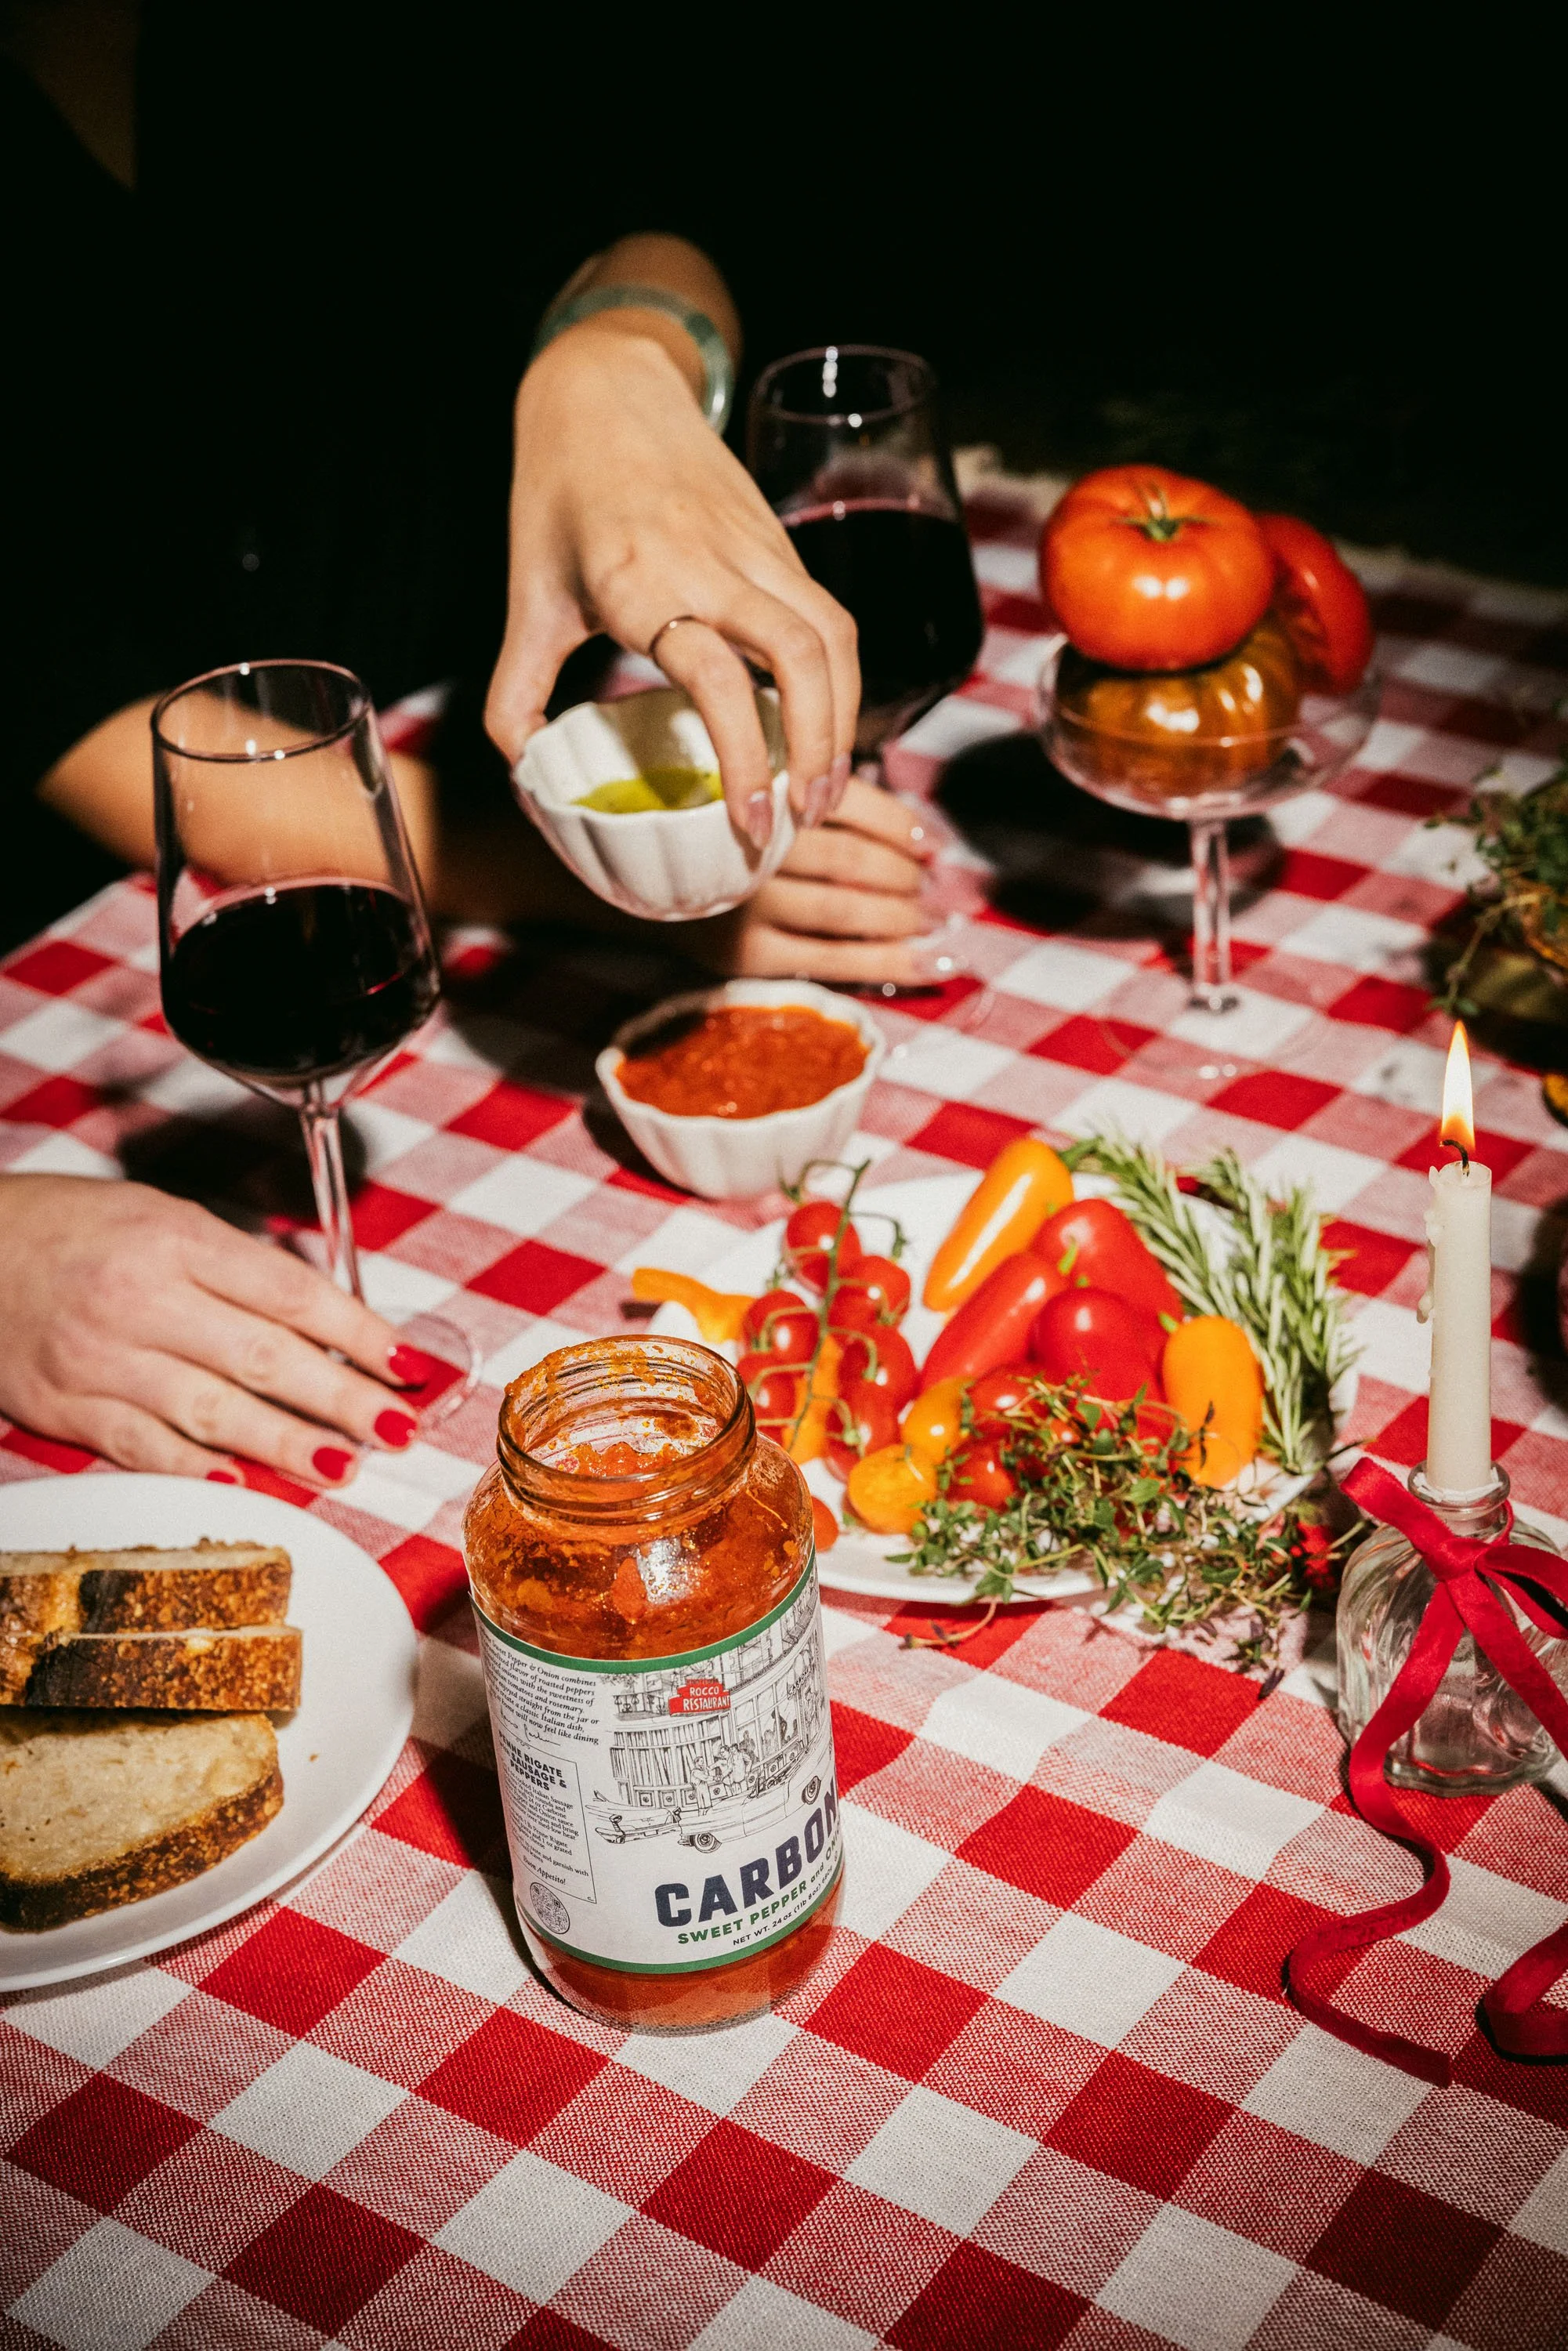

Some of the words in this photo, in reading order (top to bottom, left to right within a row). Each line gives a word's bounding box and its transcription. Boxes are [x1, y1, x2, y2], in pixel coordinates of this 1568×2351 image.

[508, 1652, 527, 1667] Pepper
[537, 1667, 559, 1679] Onion
[561, 1677, 596, 1686] combines
[510, 1662, 529, 1677] flavor
[538, 1678, 564, 1690] roasted
[566, 1686, 595, 1696] peppers
[498, 1681, 517, 1698] enjoyed
[519, 1696, 542, 1711] straight
[544, 1706, 561, 1718] from
[576, 1714, 589, 1723] jar
[501, 1667, 519, 1681] onions
[520, 1679, 535, 1689] with
[537, 1686, 547, 1694] the
[549, 1691, 584, 1704] sweetness
[585, 1698, 595, 1707] of
[508, 1679, 534, 1697] tomatoes
[534, 1695, 548, 1704] and
[549, 1701, 585, 1715] rosemary.
[690, 1686, 719, 1697] ROCCO
[500, 1690, 514, 1704] create
[520, 1705, 539, 1718] classic
[541, 1714, 565, 1727] Italian
[567, 1722, 585, 1733] dish,
[502, 1698, 514, 1713] home
[516, 1710, 527, 1722] will
[528, 1719, 543, 1729] now
[544, 1724, 556, 1734] feel
[558, 1729, 571, 1739] like
[683, 1695, 730, 1711] RESTAURANT
[498, 1730, 523, 1758] PENNE
[523, 1753, 563, 1778] RIGATE
[509, 1759, 550, 1791] PEPPERS
[511, 1752, 556, 1784] SAUSAGE
[559, 1779, 567, 1788] &
[532, 1788, 549, 1800] Italian
[550, 1795, 574, 1809] Sausage
[534, 1795, 554, 1808] rounds
[541, 1804, 567, 1819] Carbone
[527, 1808, 549, 1824] saucepan
[562, 1824, 579, 1837] bring
[528, 1803, 538, 1812] and
[538, 1808, 556, 1821] Onion
[557, 1818, 574, 1828] sauce
[538, 1820, 562, 1835] med-low
[532, 1826, 549, 1838] Penne
[549, 1835, 568, 1848] Rigate
[553, 1845, 573, 1856] grated
[654, 1776, 837, 1928] CARBON
[523, 1855, 537, 1871] Buon
[537, 1867, 566, 1885] Appetito!
[529, 1849, 544, 1863] leaves
[552, 1860, 574, 1872] garnish
[574, 1868, 588, 1877] with
[677, 1918, 744, 1945] SWEET
[750, 1879, 808, 1925] PEPPER
[810, 1862, 824, 1883] and
[733, 1933, 751, 1946] NET
[754, 1925, 770, 1936] WT.
[772, 1917, 782, 1928] 24
[783, 1911, 792, 1921] oz
[794, 1900, 807, 1914] (1lb
